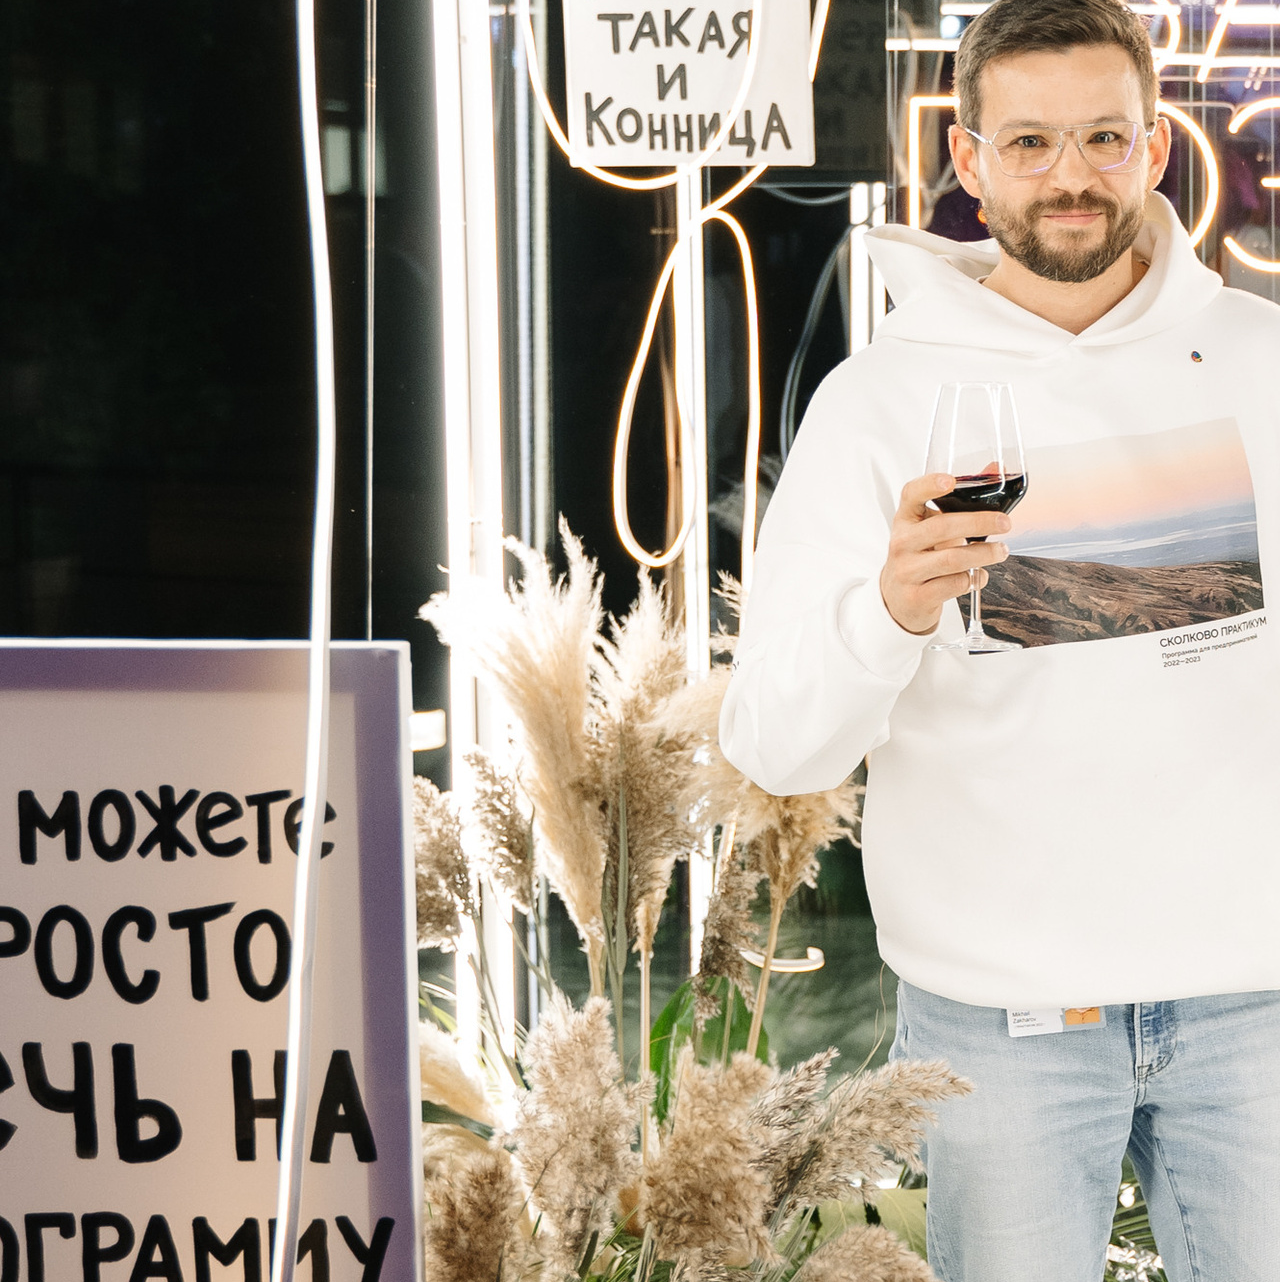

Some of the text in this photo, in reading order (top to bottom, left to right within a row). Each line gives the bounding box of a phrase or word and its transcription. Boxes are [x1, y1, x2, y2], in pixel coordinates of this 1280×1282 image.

[1159, 616, 1267, 648] СКОЛКОВО ПРАКТИКУМ
[1161, 647, 1199, 659] Программа
